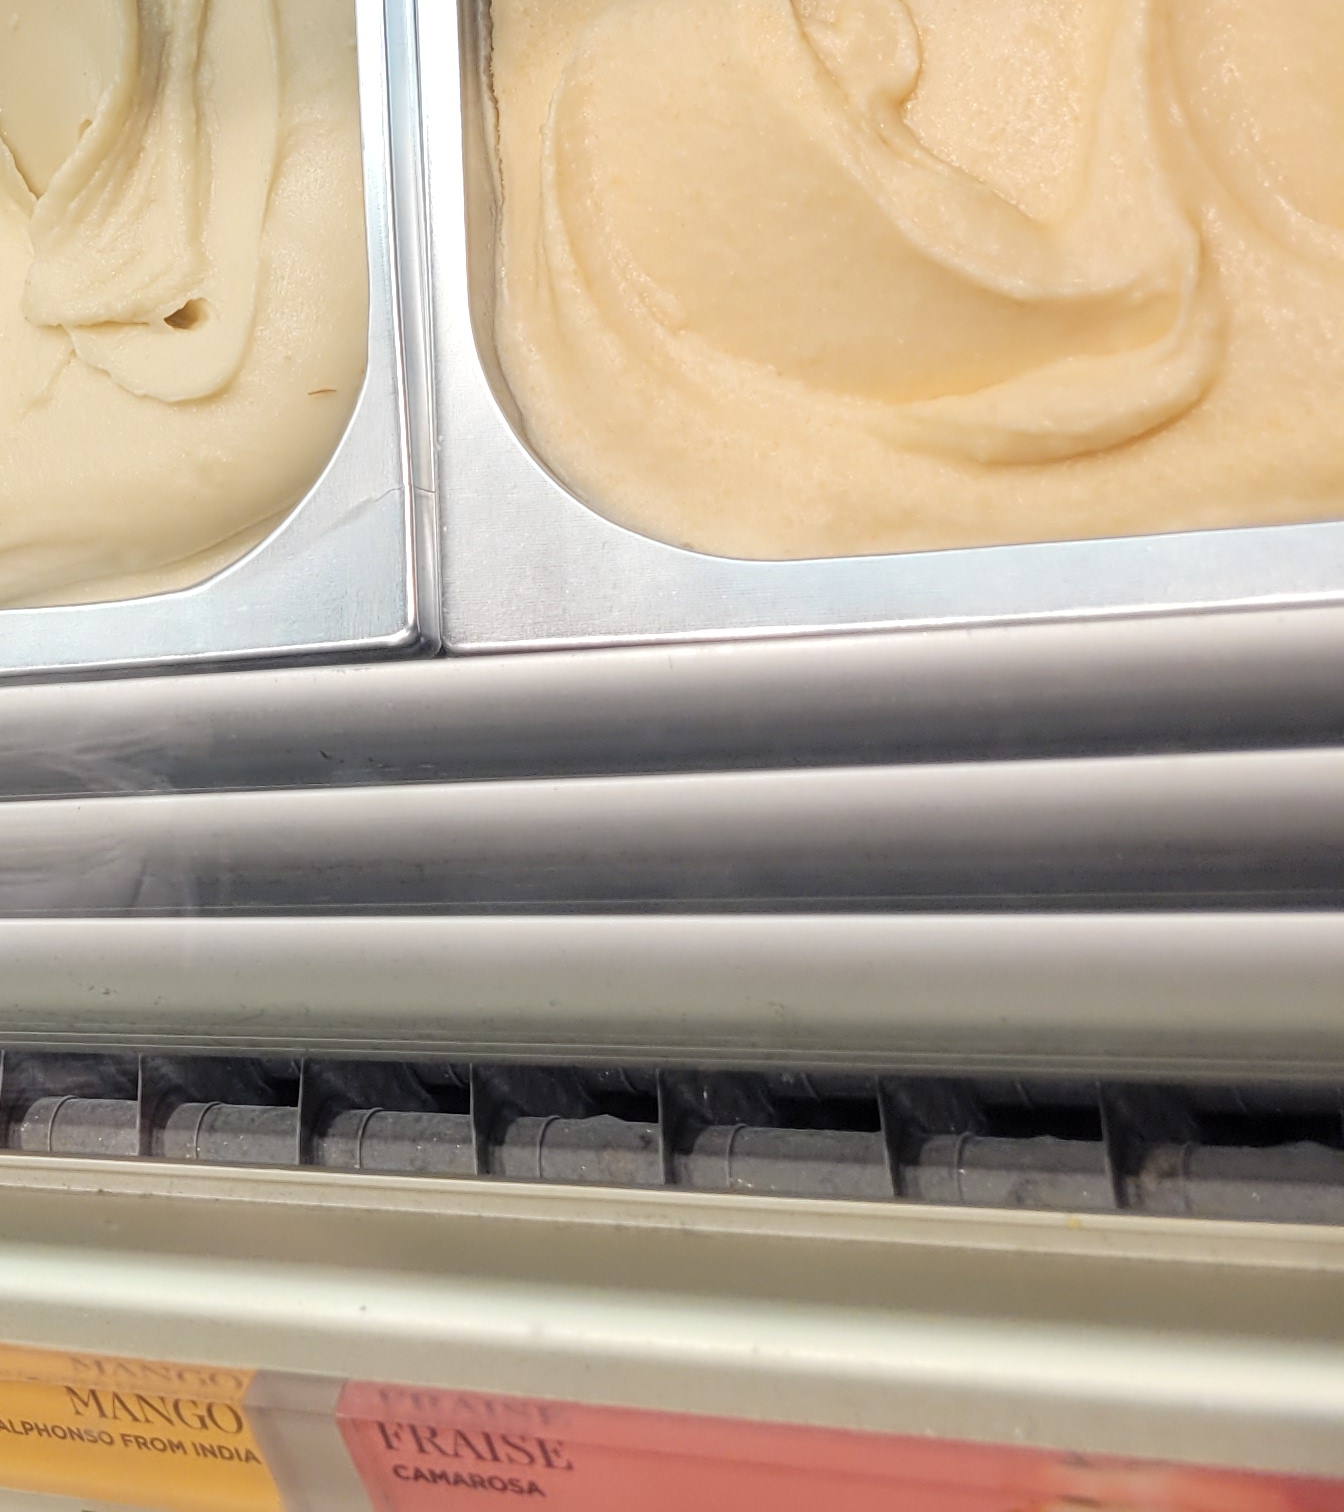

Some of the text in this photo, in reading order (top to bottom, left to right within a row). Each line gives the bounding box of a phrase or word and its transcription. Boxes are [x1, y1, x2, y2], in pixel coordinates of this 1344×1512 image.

[62, 1384, 244, 1436] MANGO
[119, 1432, 187, 1457] FROM
[191, 1440, 263, 1466] INDIA
[375, 1419, 574, 1472] FRAISE
[391, 1462, 547, 1498] CAMAROSA
